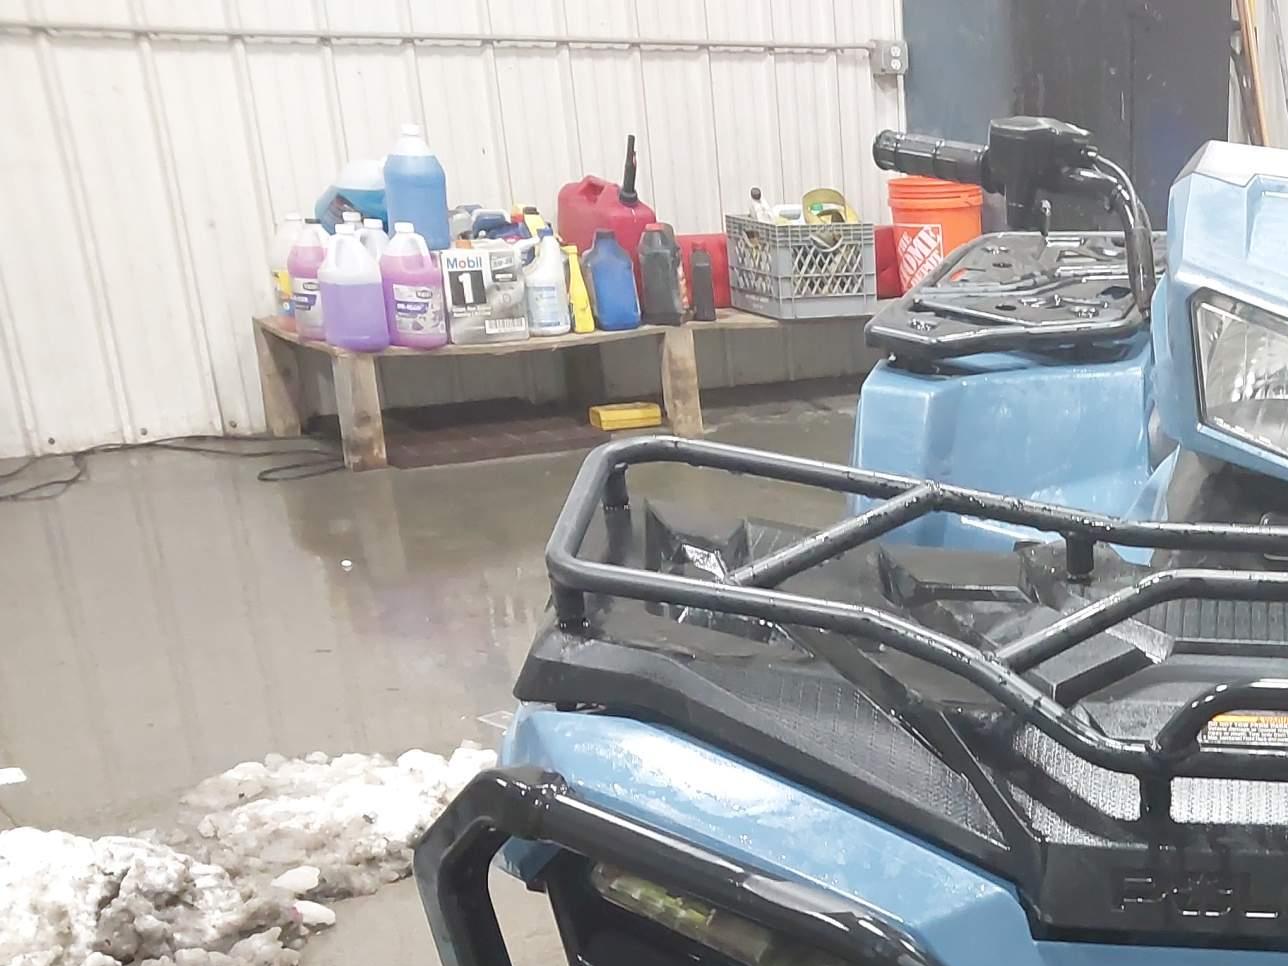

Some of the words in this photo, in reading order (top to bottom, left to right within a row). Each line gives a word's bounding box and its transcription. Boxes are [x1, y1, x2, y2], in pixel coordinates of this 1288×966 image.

[446, 255, 482, 270] Mobil
[899, 224, 941, 290] HOME
[458, 272, 474, 304] 1
